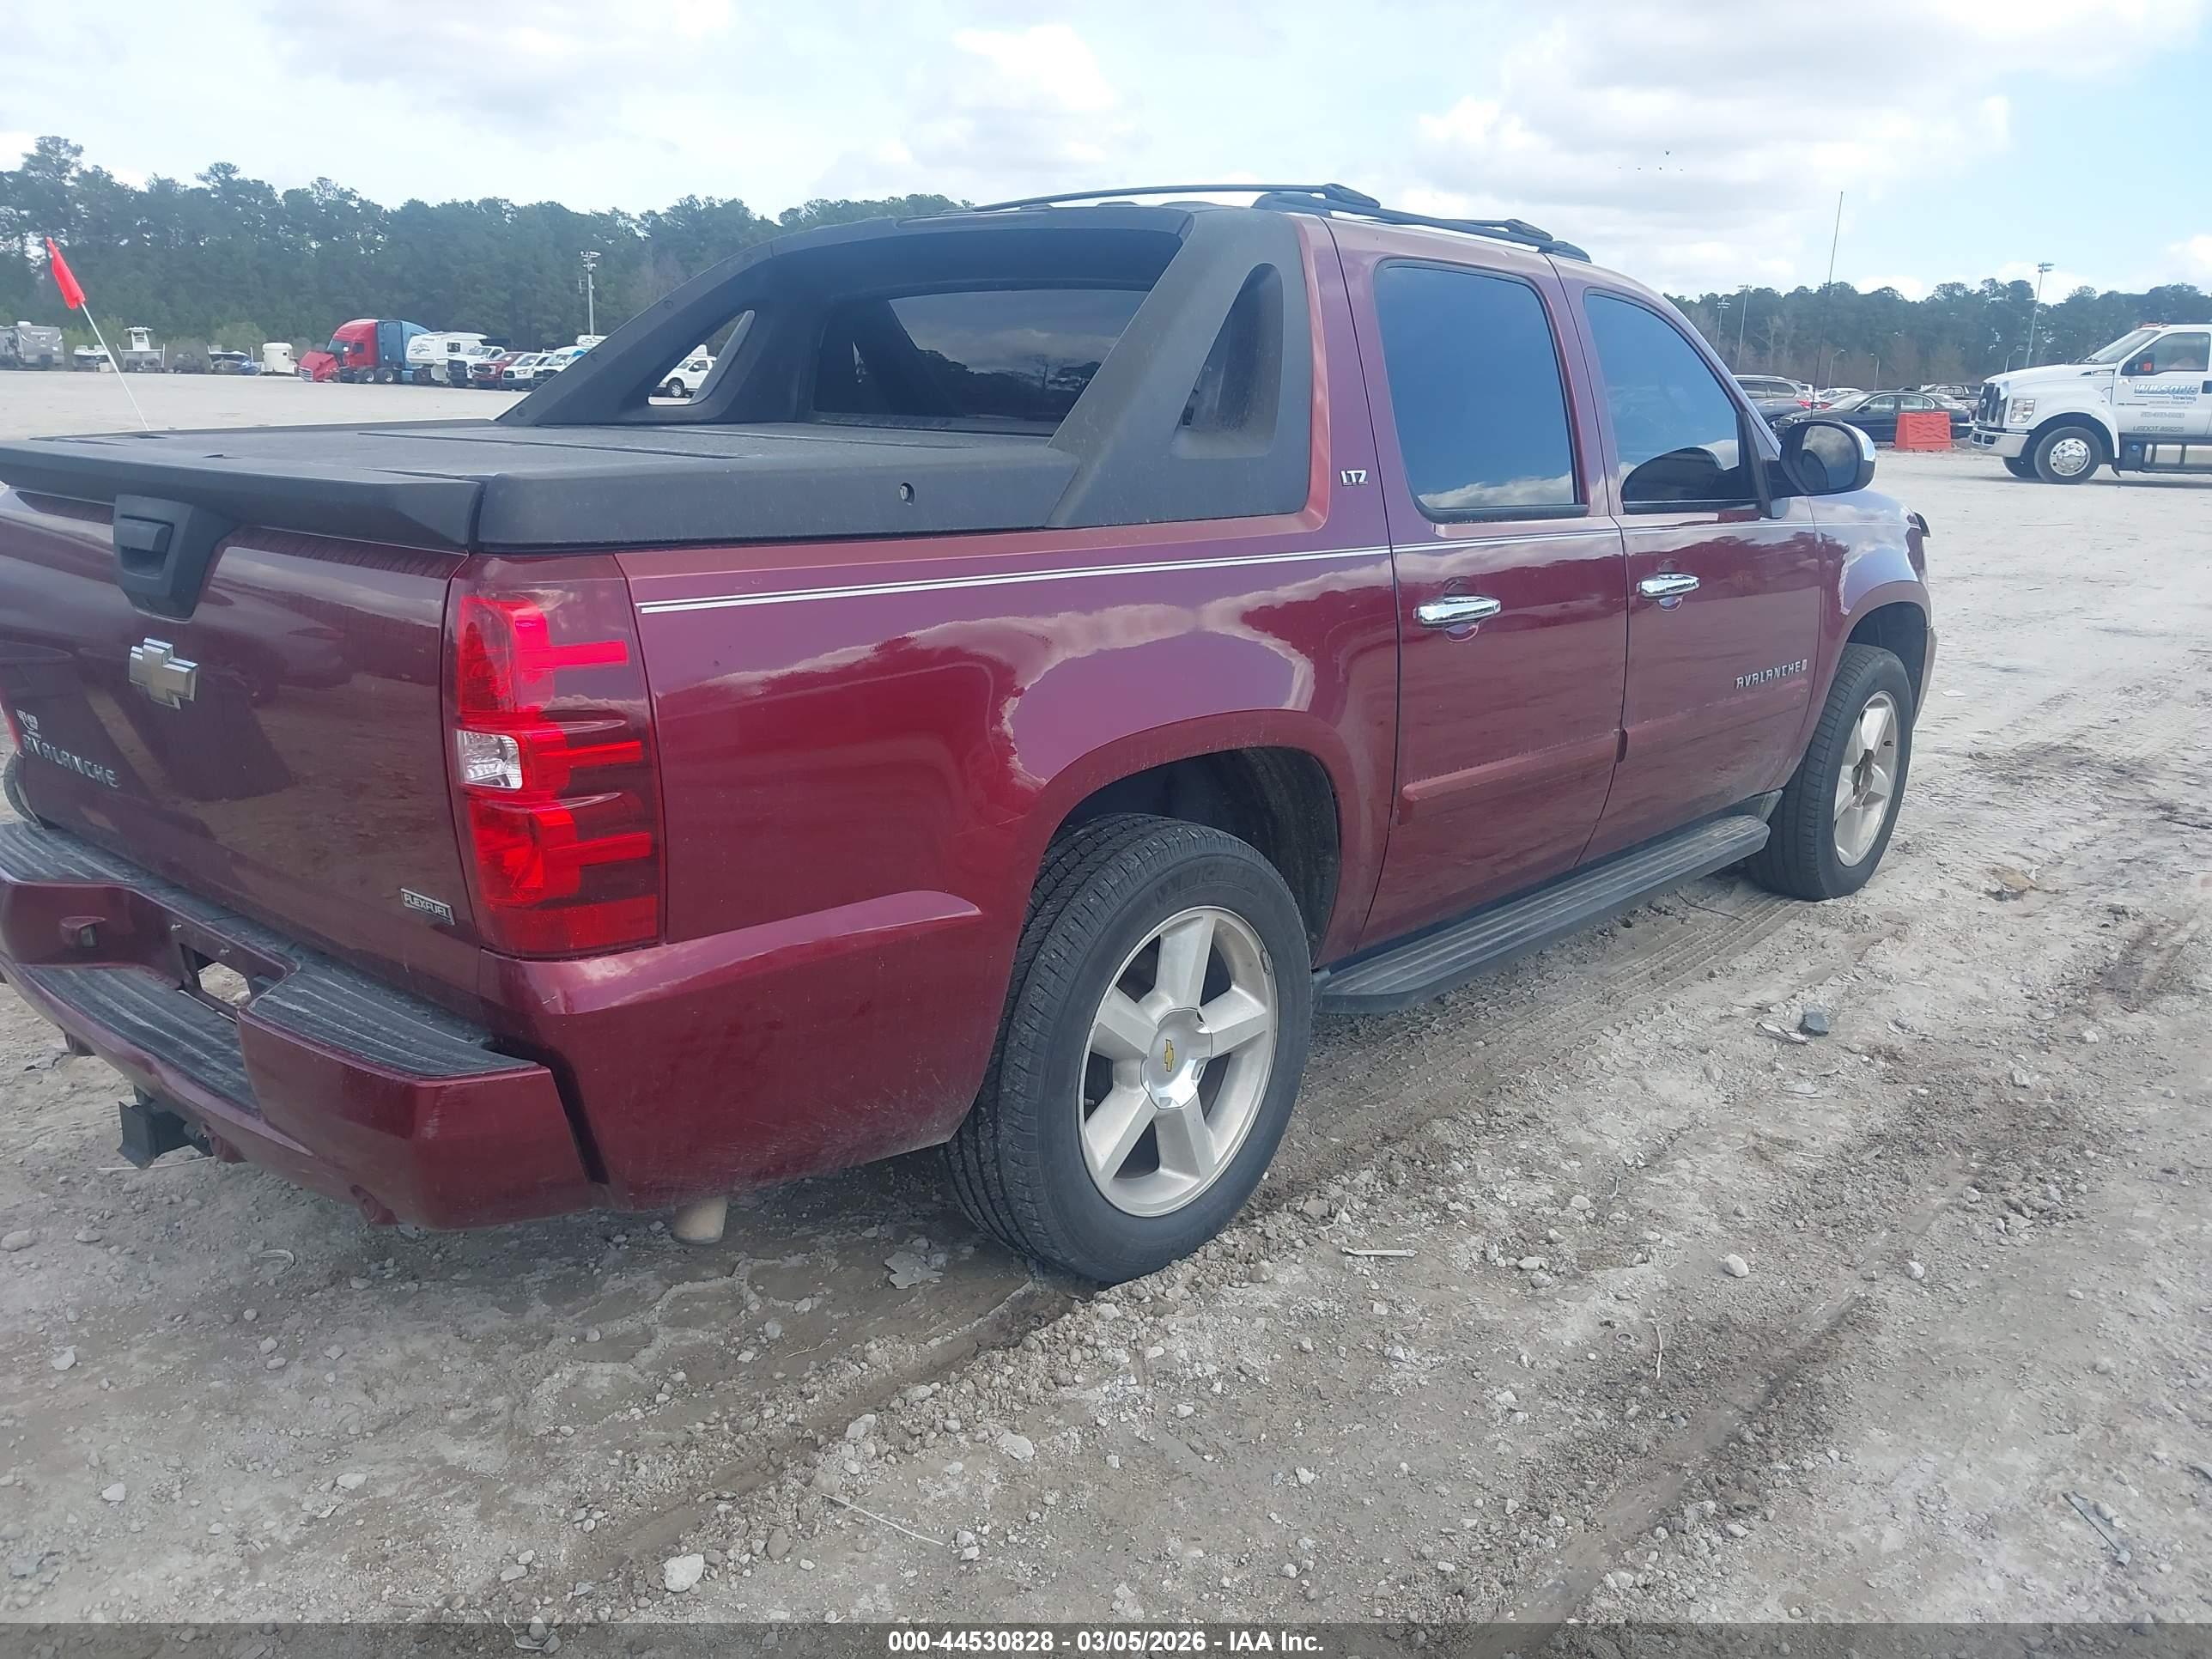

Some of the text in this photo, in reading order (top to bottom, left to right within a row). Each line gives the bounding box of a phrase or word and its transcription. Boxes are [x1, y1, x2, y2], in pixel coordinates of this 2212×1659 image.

[1340, 470, 1368, 486] LTZ
[1736, 660, 1801, 690] AVALANCHE
[22, 734, 121, 788] AVALANCHE
